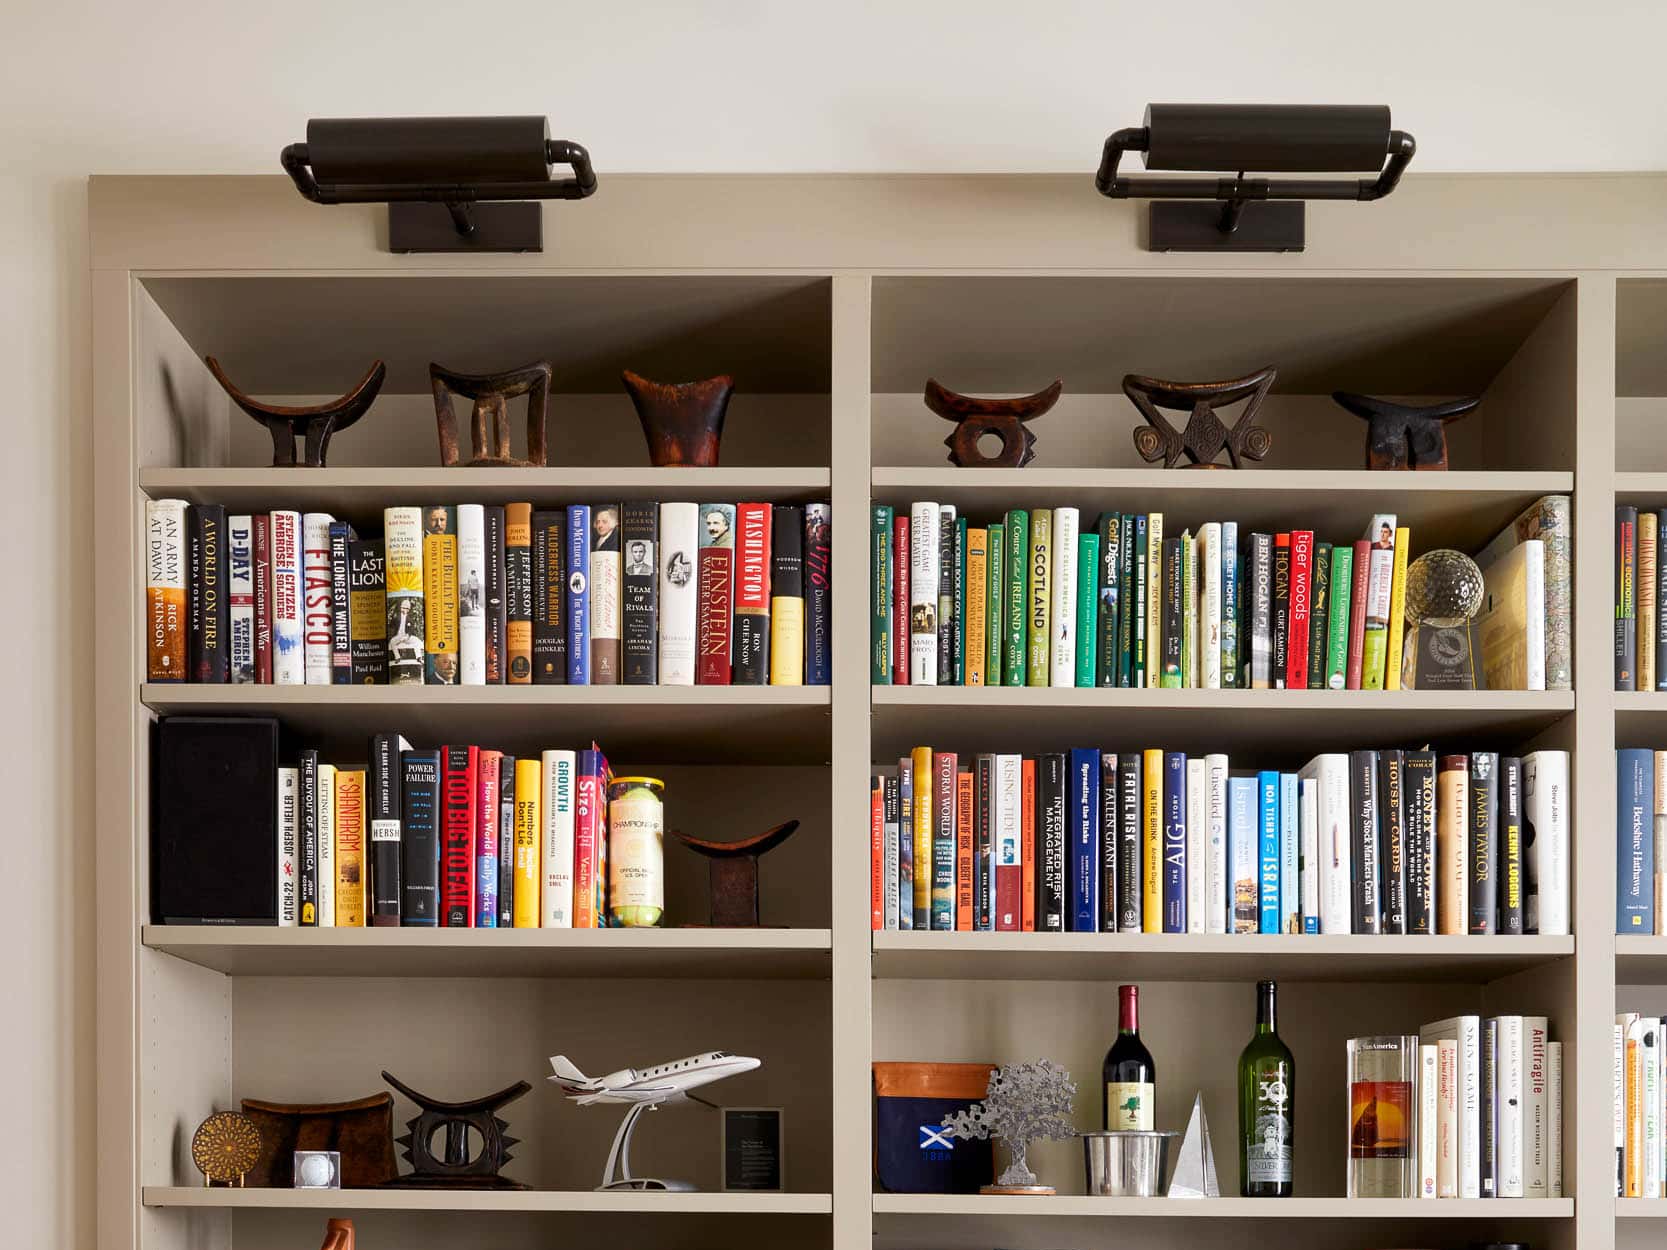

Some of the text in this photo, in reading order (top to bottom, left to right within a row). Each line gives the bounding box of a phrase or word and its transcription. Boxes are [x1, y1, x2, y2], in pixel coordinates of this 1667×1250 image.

[151, 518, 162, 582] AT DAWN
[166, 518, 178, 584] AN ARMY
[232, 529, 250, 582] D-DAY
[276, 514, 286, 567] AMBROSE
[352, 558, 384, 572] LAST
[744, 510, 764, 601] WASHINGTON
[912, 516, 921, 567] EVER PLAYED
[922, 508, 930, 572] GREATEST GAME
[941, 519, 950, 568] MATCH
[1125, 519, 1133, 573] JACK NICKLAUS
[1151, 520, 1160, 565] Golf My Way
[192, 537, 200, 631] AMANDA FOREMAN
[204, 518, 216, 649] A WORLD ON FIRE
[276, 574, 285, 620] SOLDIERS
[286, 574, 296, 620] CITIZEN
[306, 549, 332, 646] FIASCO
[332, 537, 348, 650] THE LONGEST WINTER
[352, 573, 384, 586] LION
[443, 540, 454, 642] THE BULLY PULPIT
[506, 553, 516, 616] HAMILTON
[520, 550, 532, 616] JEFFERSON
[549, 525, 558, 626] WILDERNESS WARRIOR
[1034, 544, 1046, 628] SCOTLAND
[1260, 537, 1268, 612] BEN HOGAN
[1276, 551, 1288, 599] HOGAN
[1296, 534, 1308, 620] tiger woods
[155, 588, 164, 647] ATKINSON
[168, 604, 176, 631] RICK
[701, 556, 710, 656] WALTER ISAACSON
[710, 556, 728, 656] EINSTEIN
[880, 605, 886, 618] ME
[742, 618, 750, 665] CHERNOW
[1277, 610, 1285, 667] CURT SAMPSON
[1616, 620, 1624, 656] SHILLER
[558, 760, 568, 812] GROWTH
[579, 780, 594, 816] Size
[902, 798, 910, 817] FIRE
[940, 756, 950, 836] STORM WORLD
[1081, 763, 1090, 804] Spreading
[1081, 806, 1090, 818] the
[1124, 772, 1136, 842] FATAL RISK
[1211, 766, 1222, 819] Unsettled
[1266, 784, 1275, 839] NOA TISHBY
[284, 795, 294, 857] JOSEPH HELLER
[305, 758, 313, 871] THE BUYOUT OF AMERICA
[340, 784, 360, 852] SHANTARAM
[518, 801, 526, 845] Don't Lie
[526, 801, 534, 845] Numbers
[873, 808, 882, 850] Ubiquity
[960, 779, 970, 850] THE GEOGRAPHY OF RISK
[1081, 820, 1090, 844] Risks
[1106, 788, 1116, 868] FALLEN GIANT
[1150, 790, 1158, 841] ON THE BRINK
[1475, 787, 1488, 882] JAMES TAYLOR
[480, 781, 494, 912] How the World Really Works
[1046, 807, 1054, 888] MANAGEMENT
[1054, 796, 1062, 900] INTEGRATED RISK
[1362, 800, 1375, 905] Why Stock Markets Crash
[1508, 825, 1519, 908] KENNY LOGGINS
[1630, 806, 1644, 896] Berkshire Hathaway
[284, 881, 294, 921] CATCH-22
[580, 856, 590, 910] Vaclav Smil
[1263, 857, 1277, 912] ISRAEL
[1530, 1029, 1544, 1094] Antifragile
